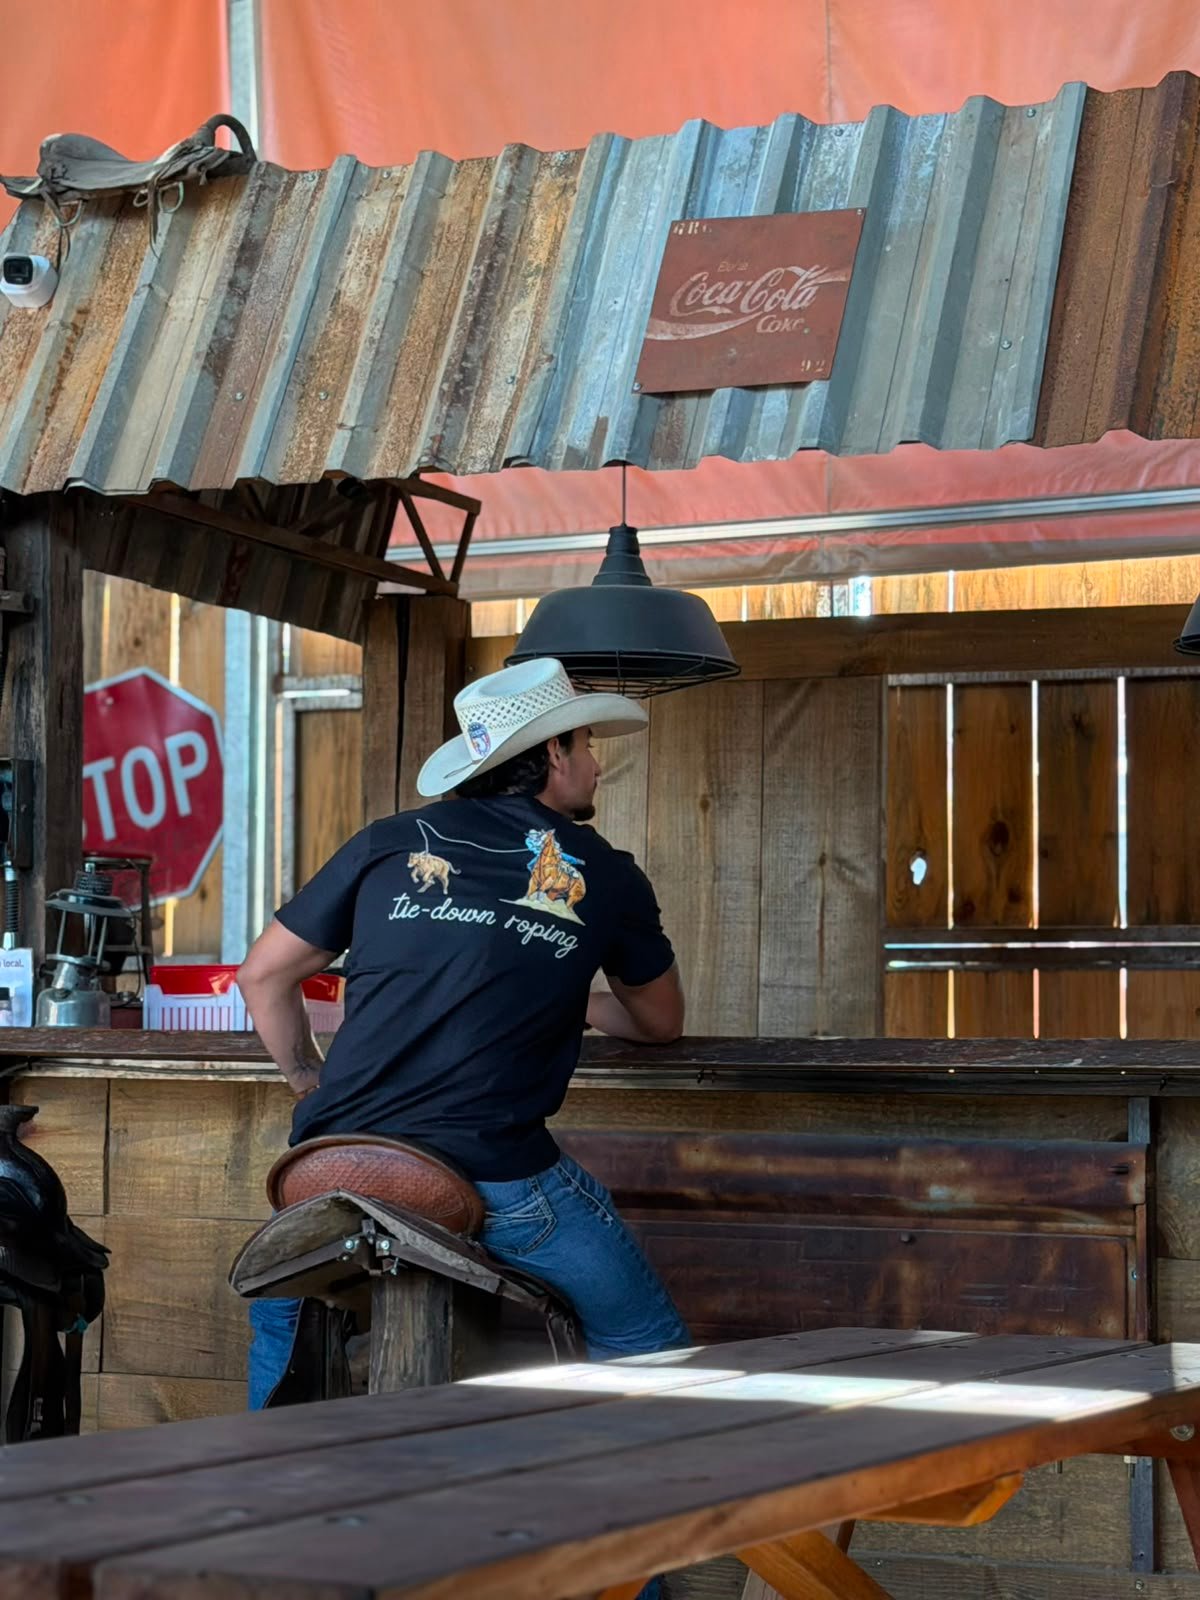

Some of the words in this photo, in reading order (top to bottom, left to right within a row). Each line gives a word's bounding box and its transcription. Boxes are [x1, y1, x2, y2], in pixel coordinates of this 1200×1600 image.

[670, 264, 828, 316] Coca-Cola
[83, 730, 208, 842] TOP
[388, 893, 496, 925] tie-down
[504, 915, 579, 958] roping
